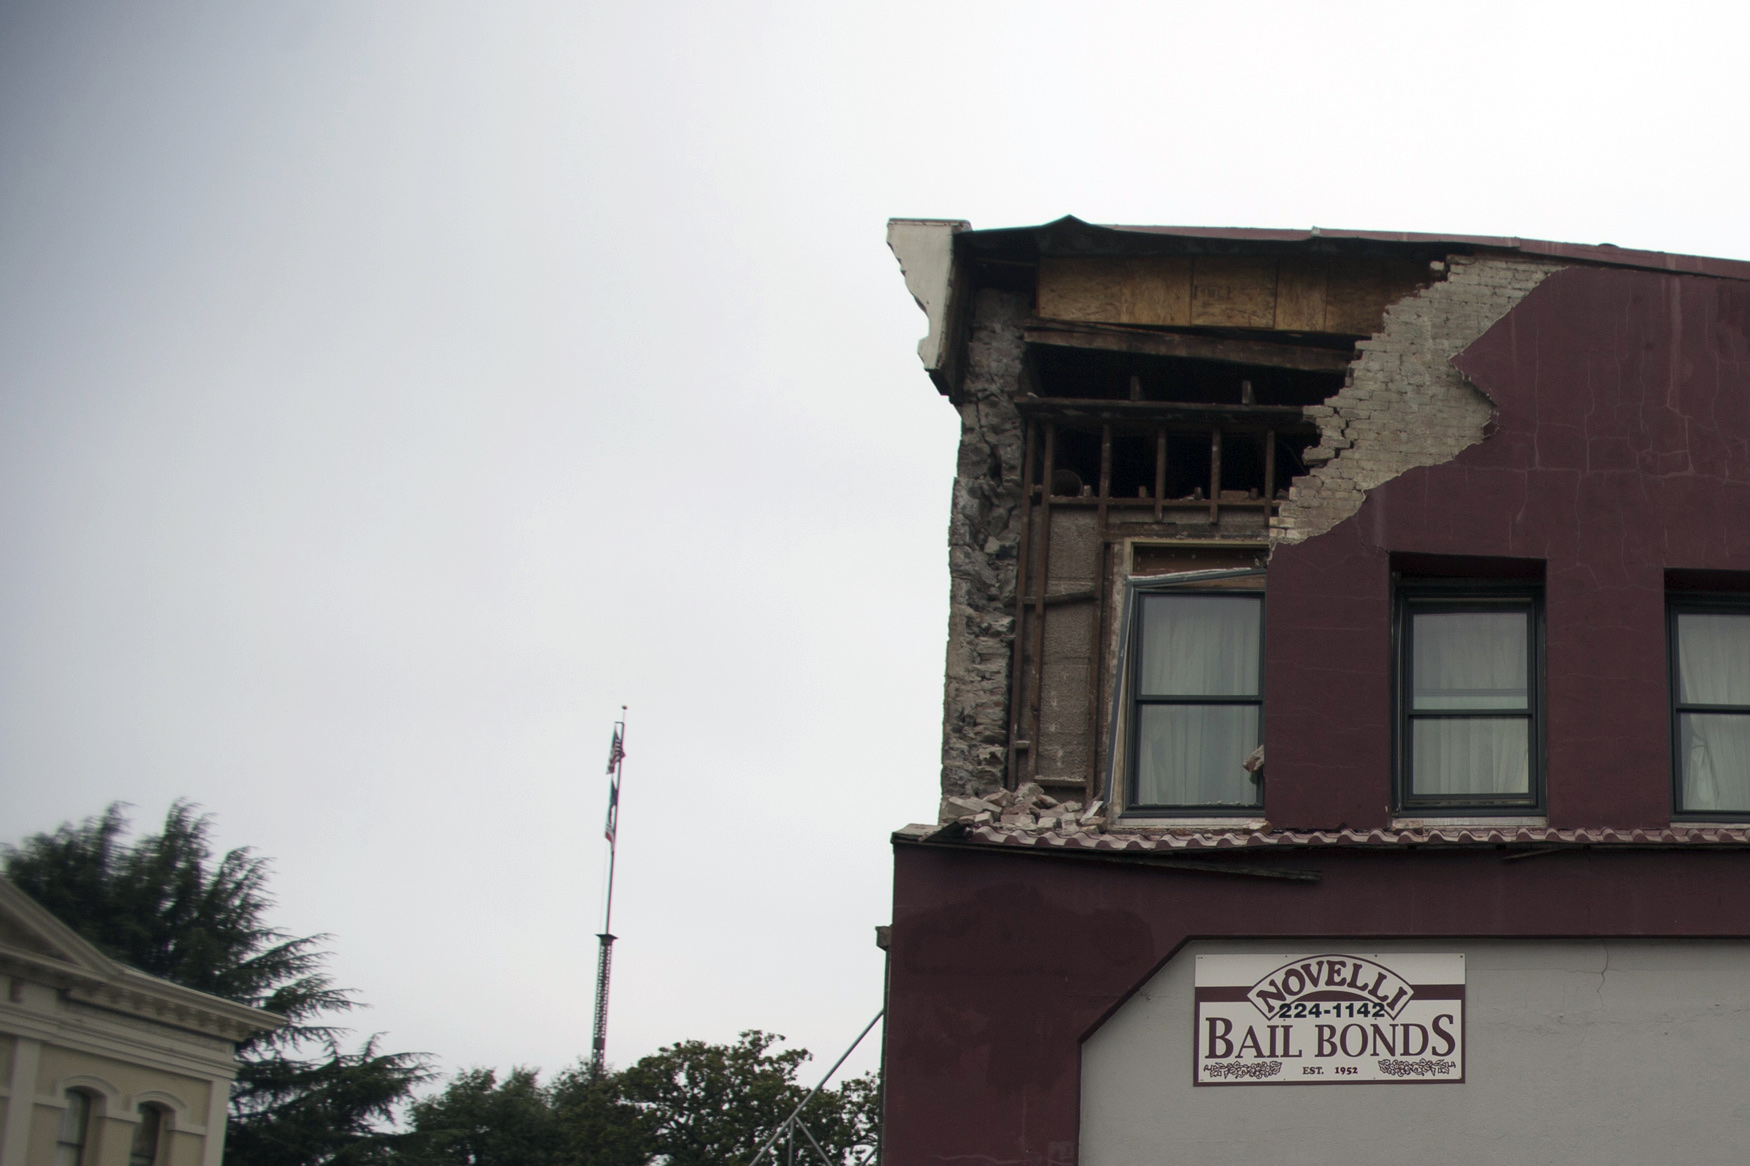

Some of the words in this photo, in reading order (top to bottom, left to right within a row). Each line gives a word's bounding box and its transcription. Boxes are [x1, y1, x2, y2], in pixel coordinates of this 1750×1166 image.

[1256, 960, 1408, 1014] NOVELLI
[1278, 1002, 1385, 1018] 224-1142
[1204, 1017, 1302, 1059] BAIL
[1314, 1014, 1456, 1058] BONDS
[1302, 1066, 1324, 1074] EST.
[1334, 1066, 1358, 1074] 1952
